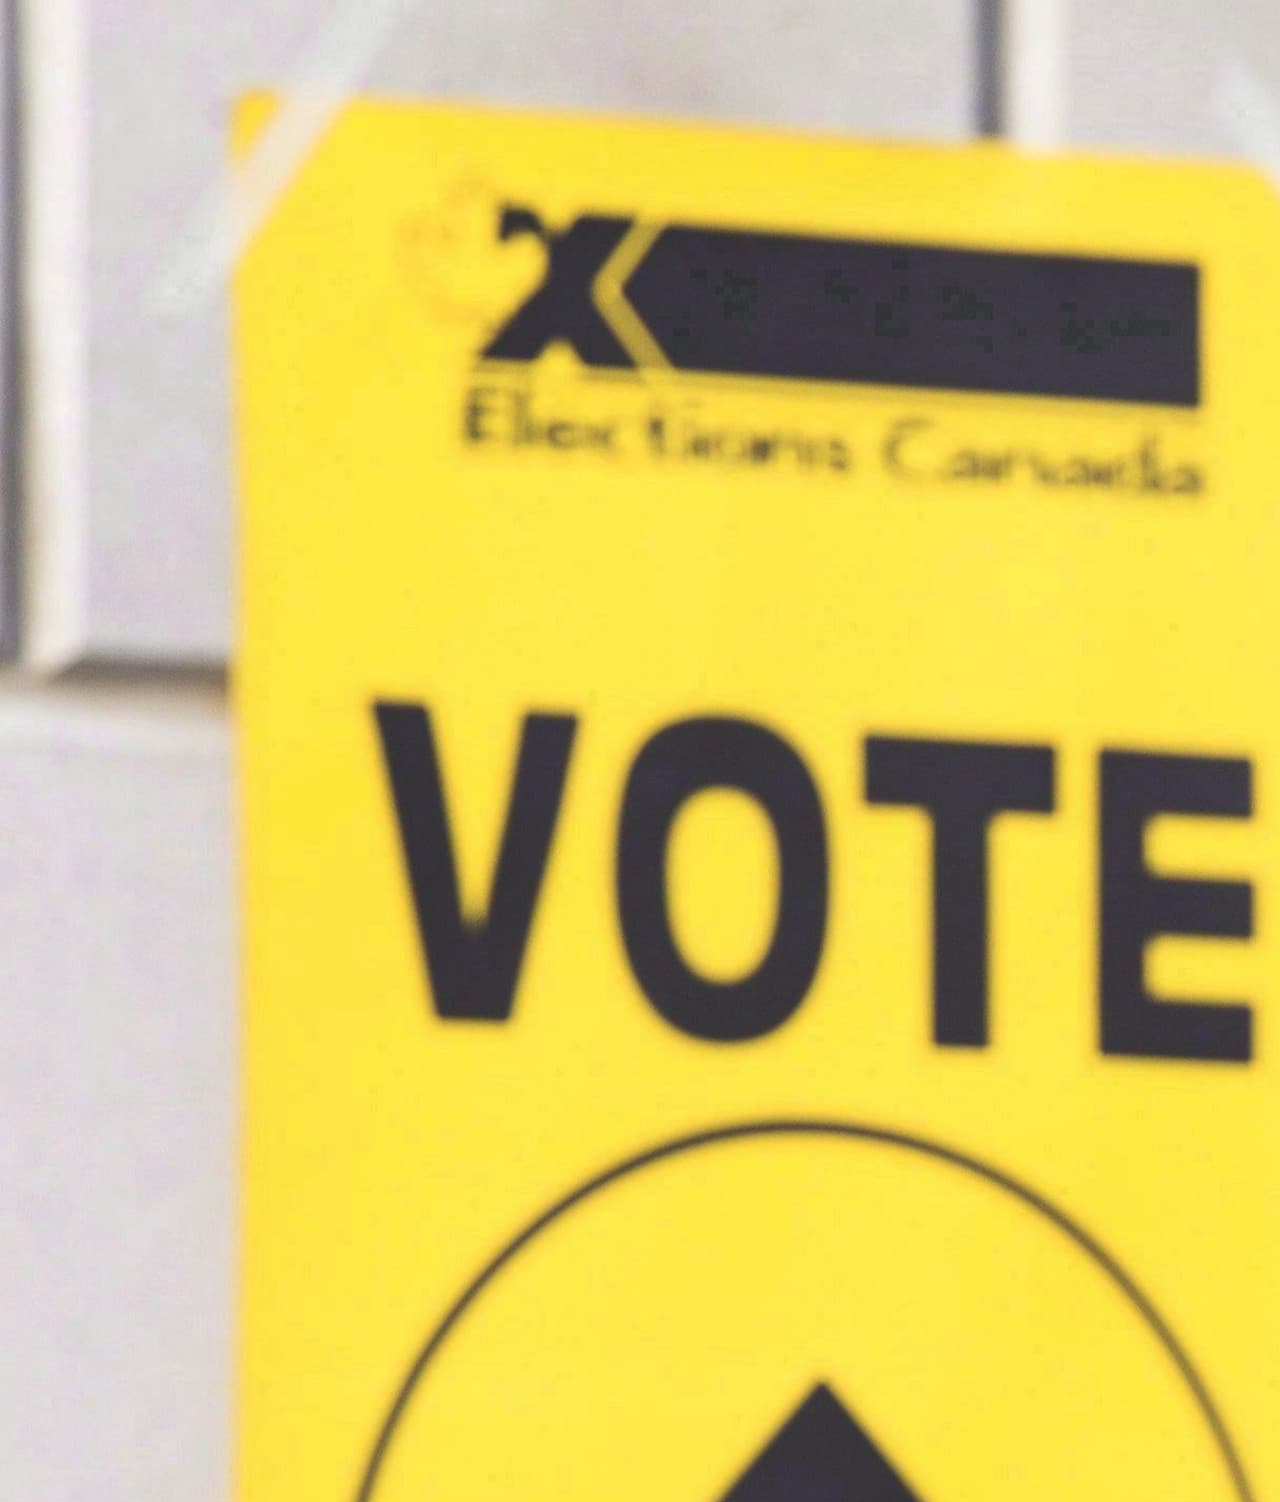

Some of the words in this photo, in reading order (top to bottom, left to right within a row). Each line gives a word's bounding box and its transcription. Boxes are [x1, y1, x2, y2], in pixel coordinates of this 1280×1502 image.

[462, 386, 851, 475] Elections
[883, 414, 1207, 498] Canada
[370, 696, 1256, 1067] VOTE
